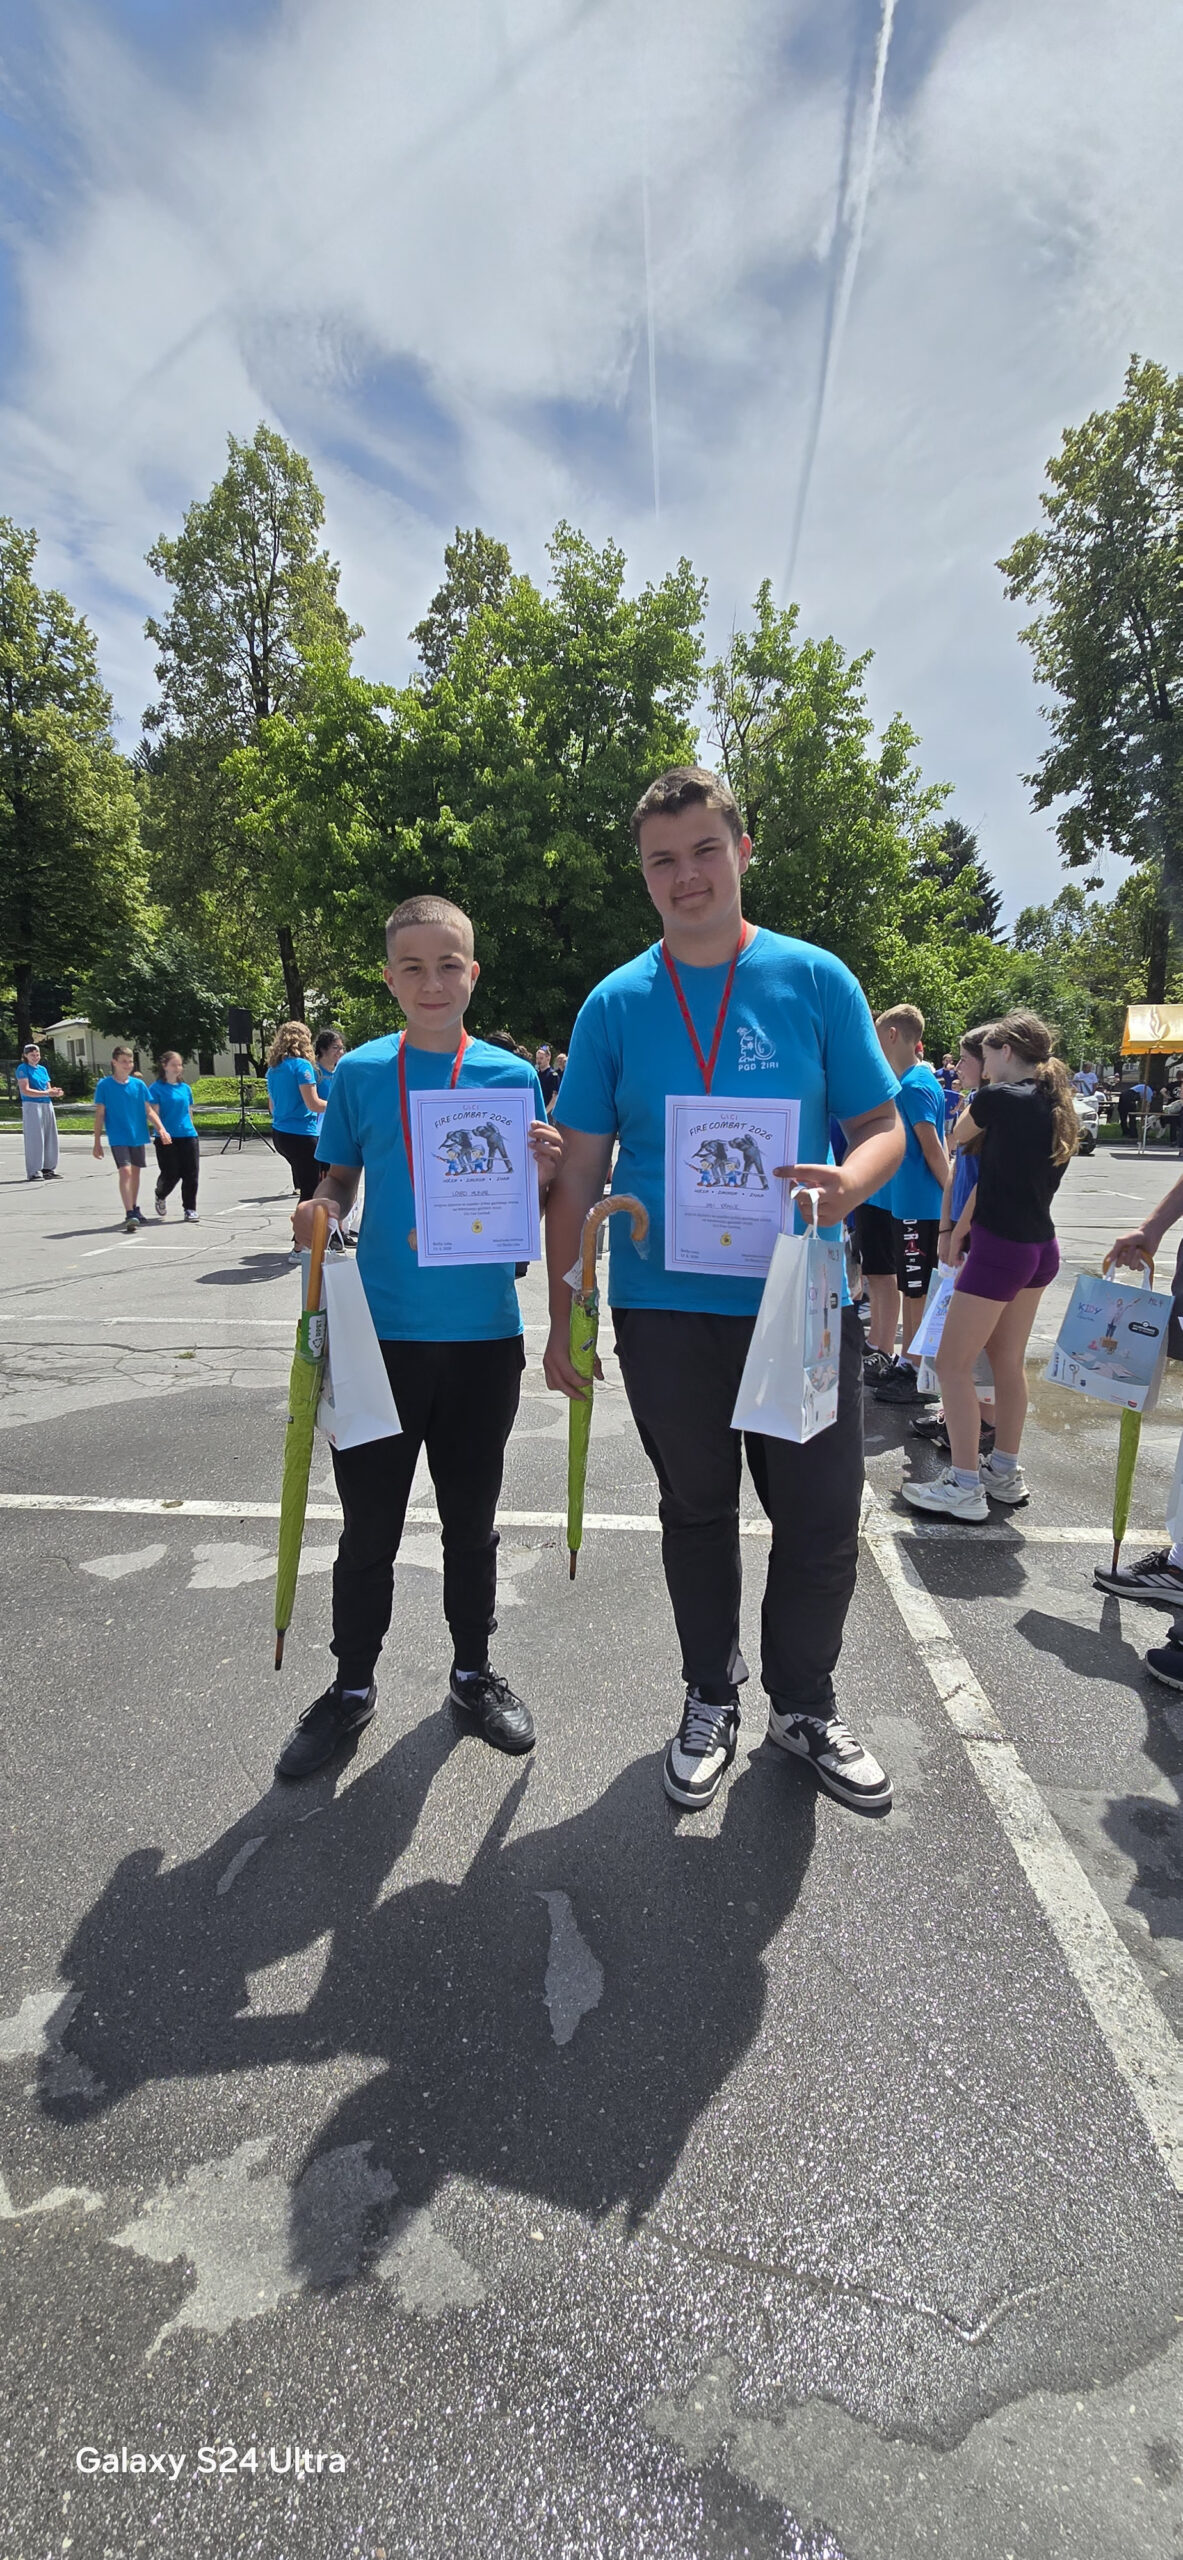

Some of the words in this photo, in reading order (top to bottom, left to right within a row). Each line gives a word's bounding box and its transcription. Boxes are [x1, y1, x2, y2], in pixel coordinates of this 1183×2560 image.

[738, 1063, 757, 1072] PGD
[434, 1115, 451, 1128] FIRE
[452, 1111, 488, 1120] COMBAT
[489, 1113, 513, 1126] 2026
[689, 1123, 707, 1136] FIRE
[708, 1121, 747, 1130] COMBAT
[748, 1125, 773, 1140] 2026
